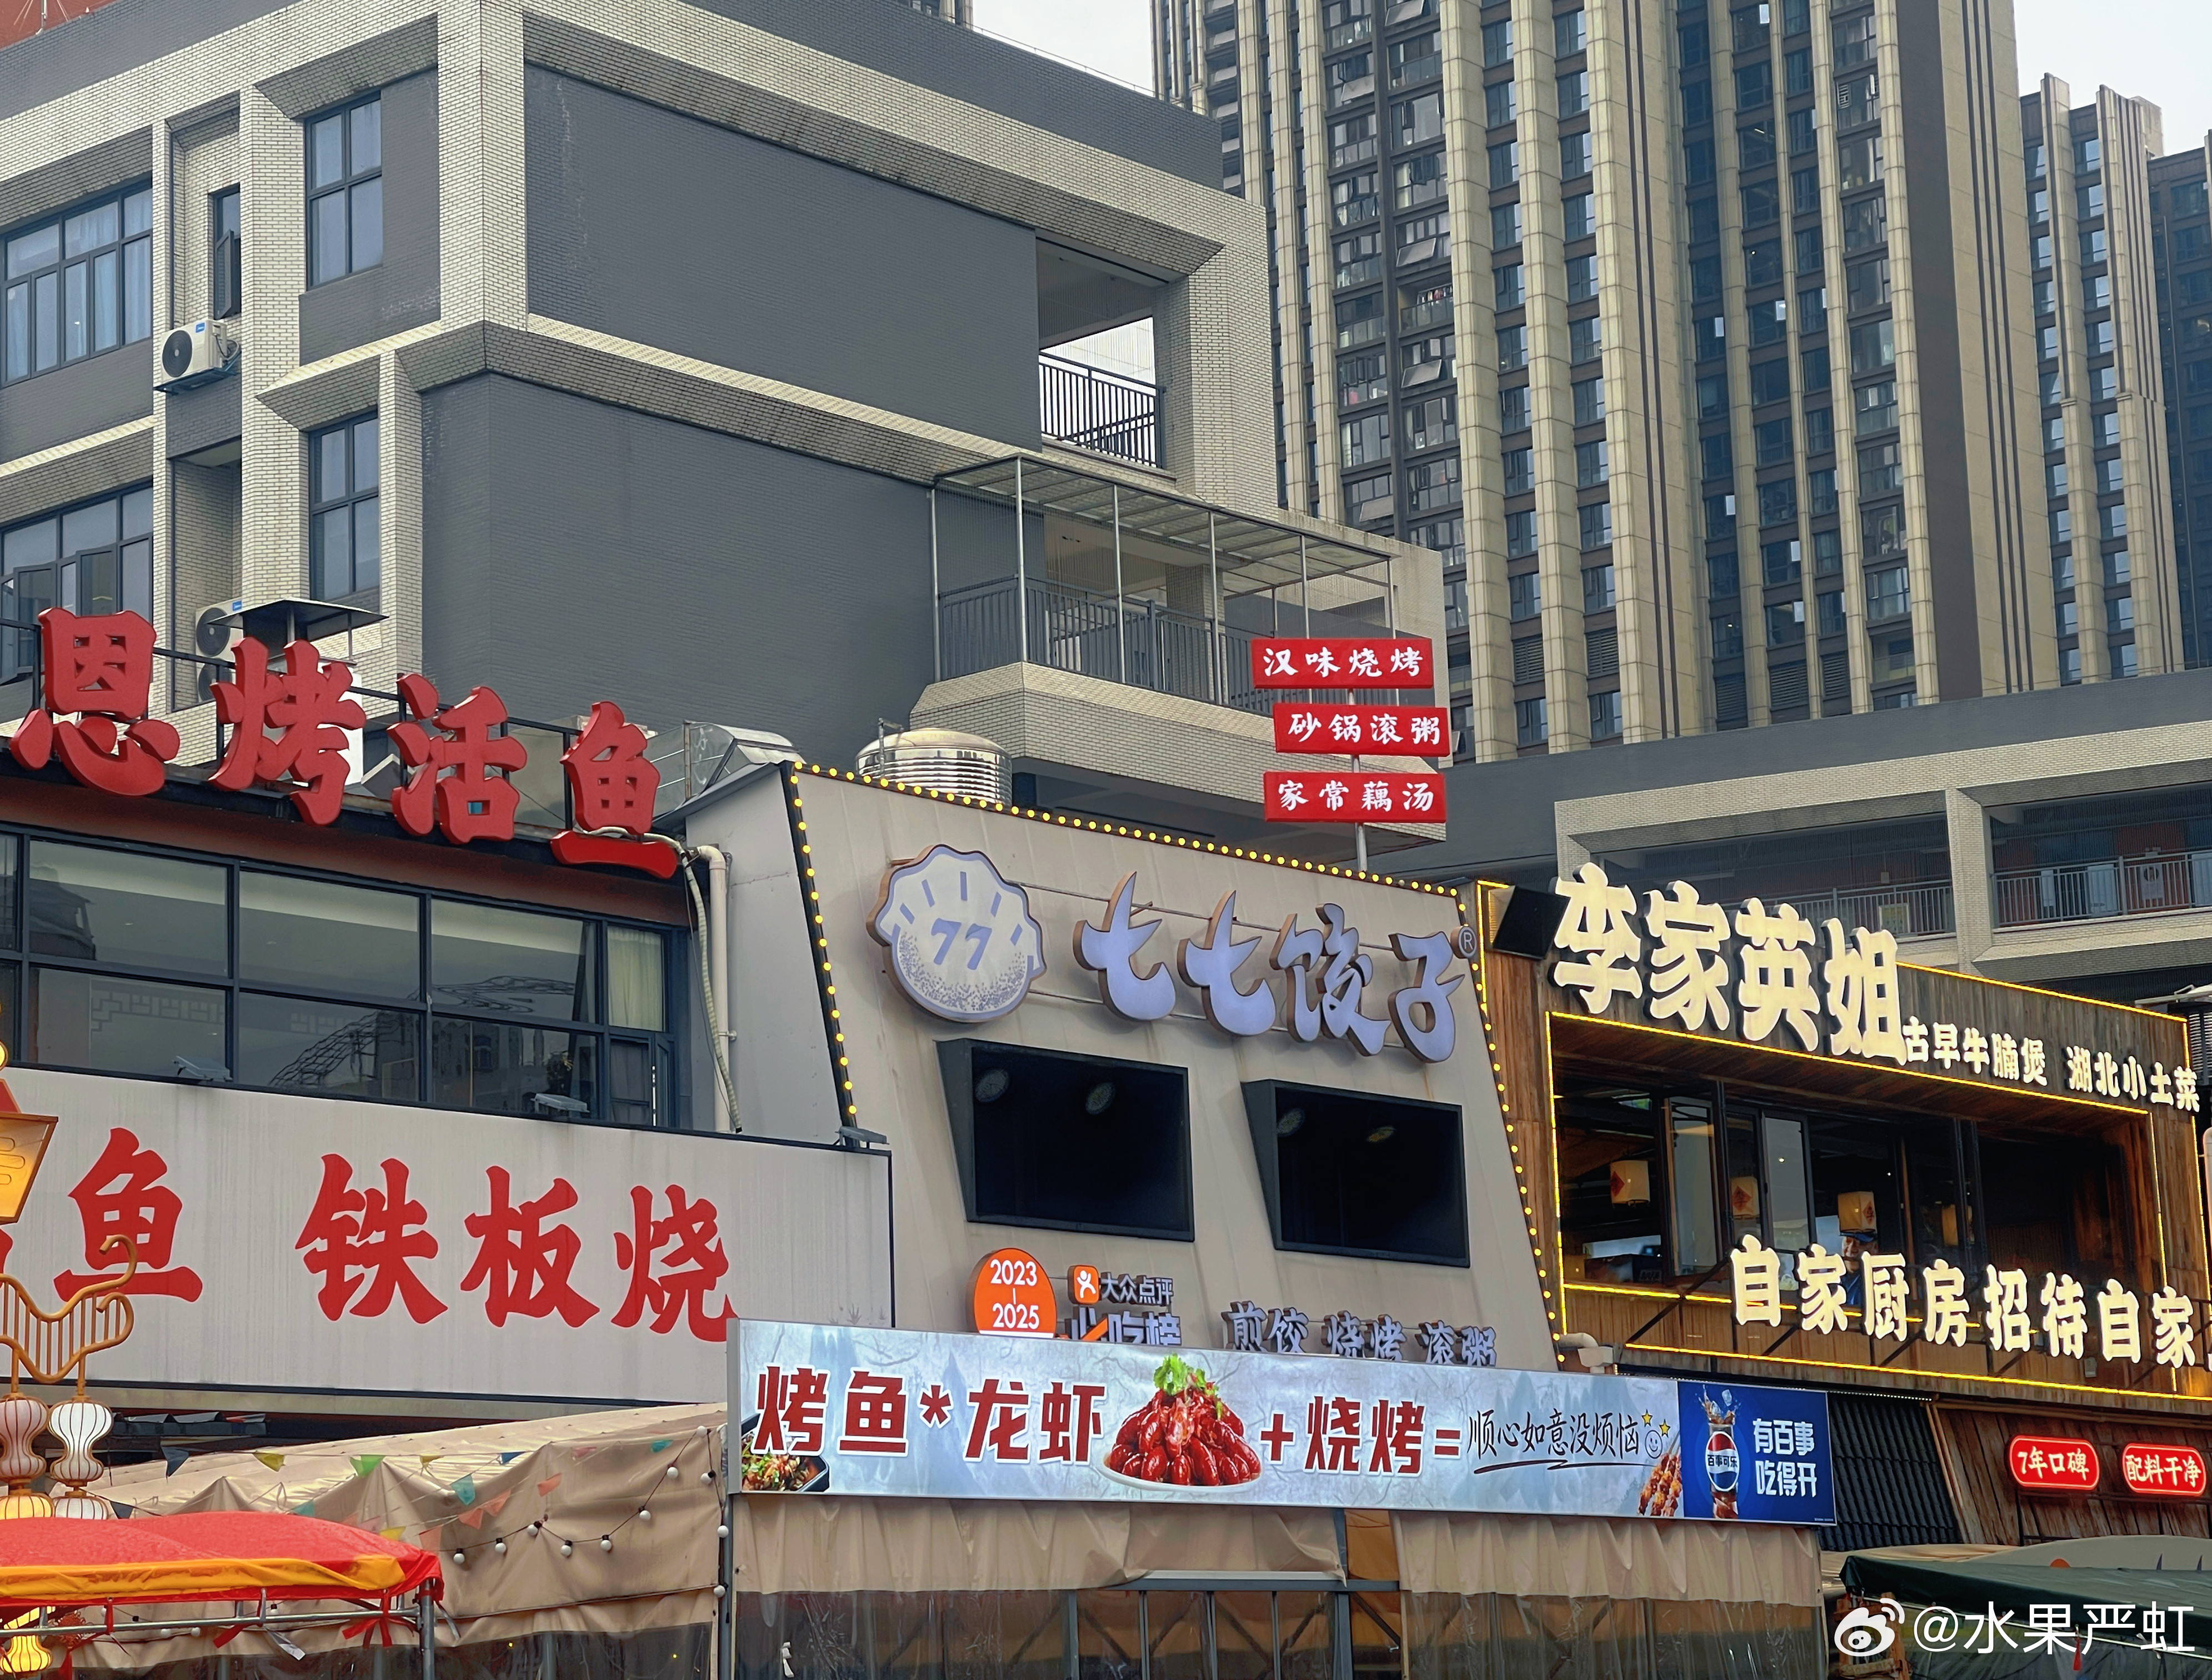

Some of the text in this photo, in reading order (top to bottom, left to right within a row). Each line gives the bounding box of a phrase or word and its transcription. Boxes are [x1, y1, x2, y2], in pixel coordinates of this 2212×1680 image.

[1263, 647, 1423, 678] 汉味烧烤
[9, 607, 678, 879] 恩烤活鱼
[1288, 712, 1440, 745] 砂锅滚粥
[1278, 779, 1434, 812] 家常藕汤
[1073, 871, 1464, 1064] 七七饺子
[1554, 862, 1908, 1066] 李家英姐
[1902, 1016, 2200, 1112] 古早牛腩煲 湖北小土菜
[0, 1127, 739, 1342] 鱼 铁板烧
[990, 1259, 1037, 1286] 2023
[1100, 1272, 1173, 1306] 大众点评
[992, 1303, 1039, 1329] 2025
[1730, 1234, 2212, 1372] 自家厨房招待自家
[1222, 1301, 1308, 1354] 煎饺
[1322, 1311, 1405, 1361] 烧烤
[1468, 1408, 1639, 1459] 顺心如意没烦恼
[1753, 1418, 1814, 1456] 有百事
[1707, 1454, 1738, 1467] 百事可乐
[1755, 1460, 1817, 1497] 吃得开
[2018, 1446, 2089, 1481] 7年口碑
[2125, 1454, 2201, 1487] 配料干净
